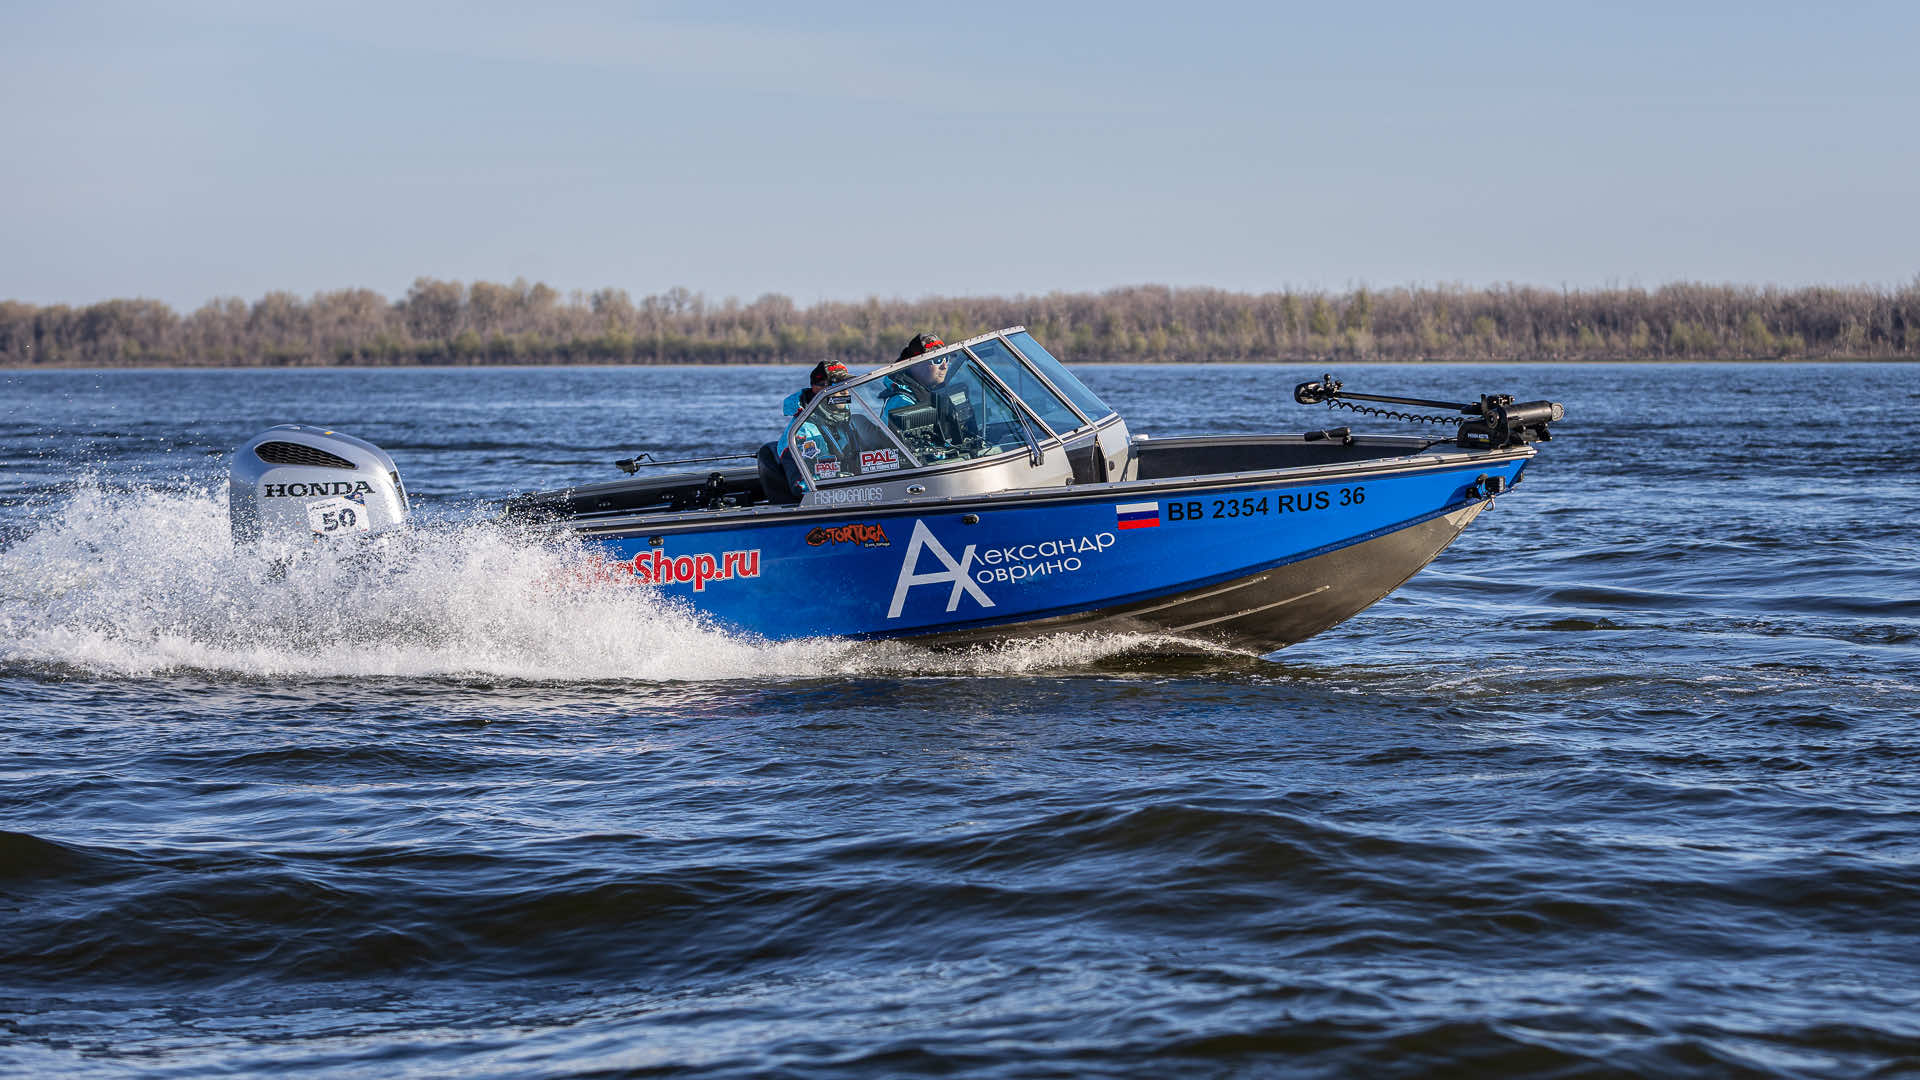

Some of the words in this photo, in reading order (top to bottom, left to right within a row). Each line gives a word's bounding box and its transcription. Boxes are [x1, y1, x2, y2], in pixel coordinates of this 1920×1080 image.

[862, 450, 896, 466] PAL
[264, 480, 376, 498] HONDA
[1212, 497, 1269, 519] 2354
[1278, 491, 1329, 514] RUS
[1339, 486, 1366, 506] 36
[322, 508, 357, 532] 50
[826, 523, 889, 546] TORTUGA
